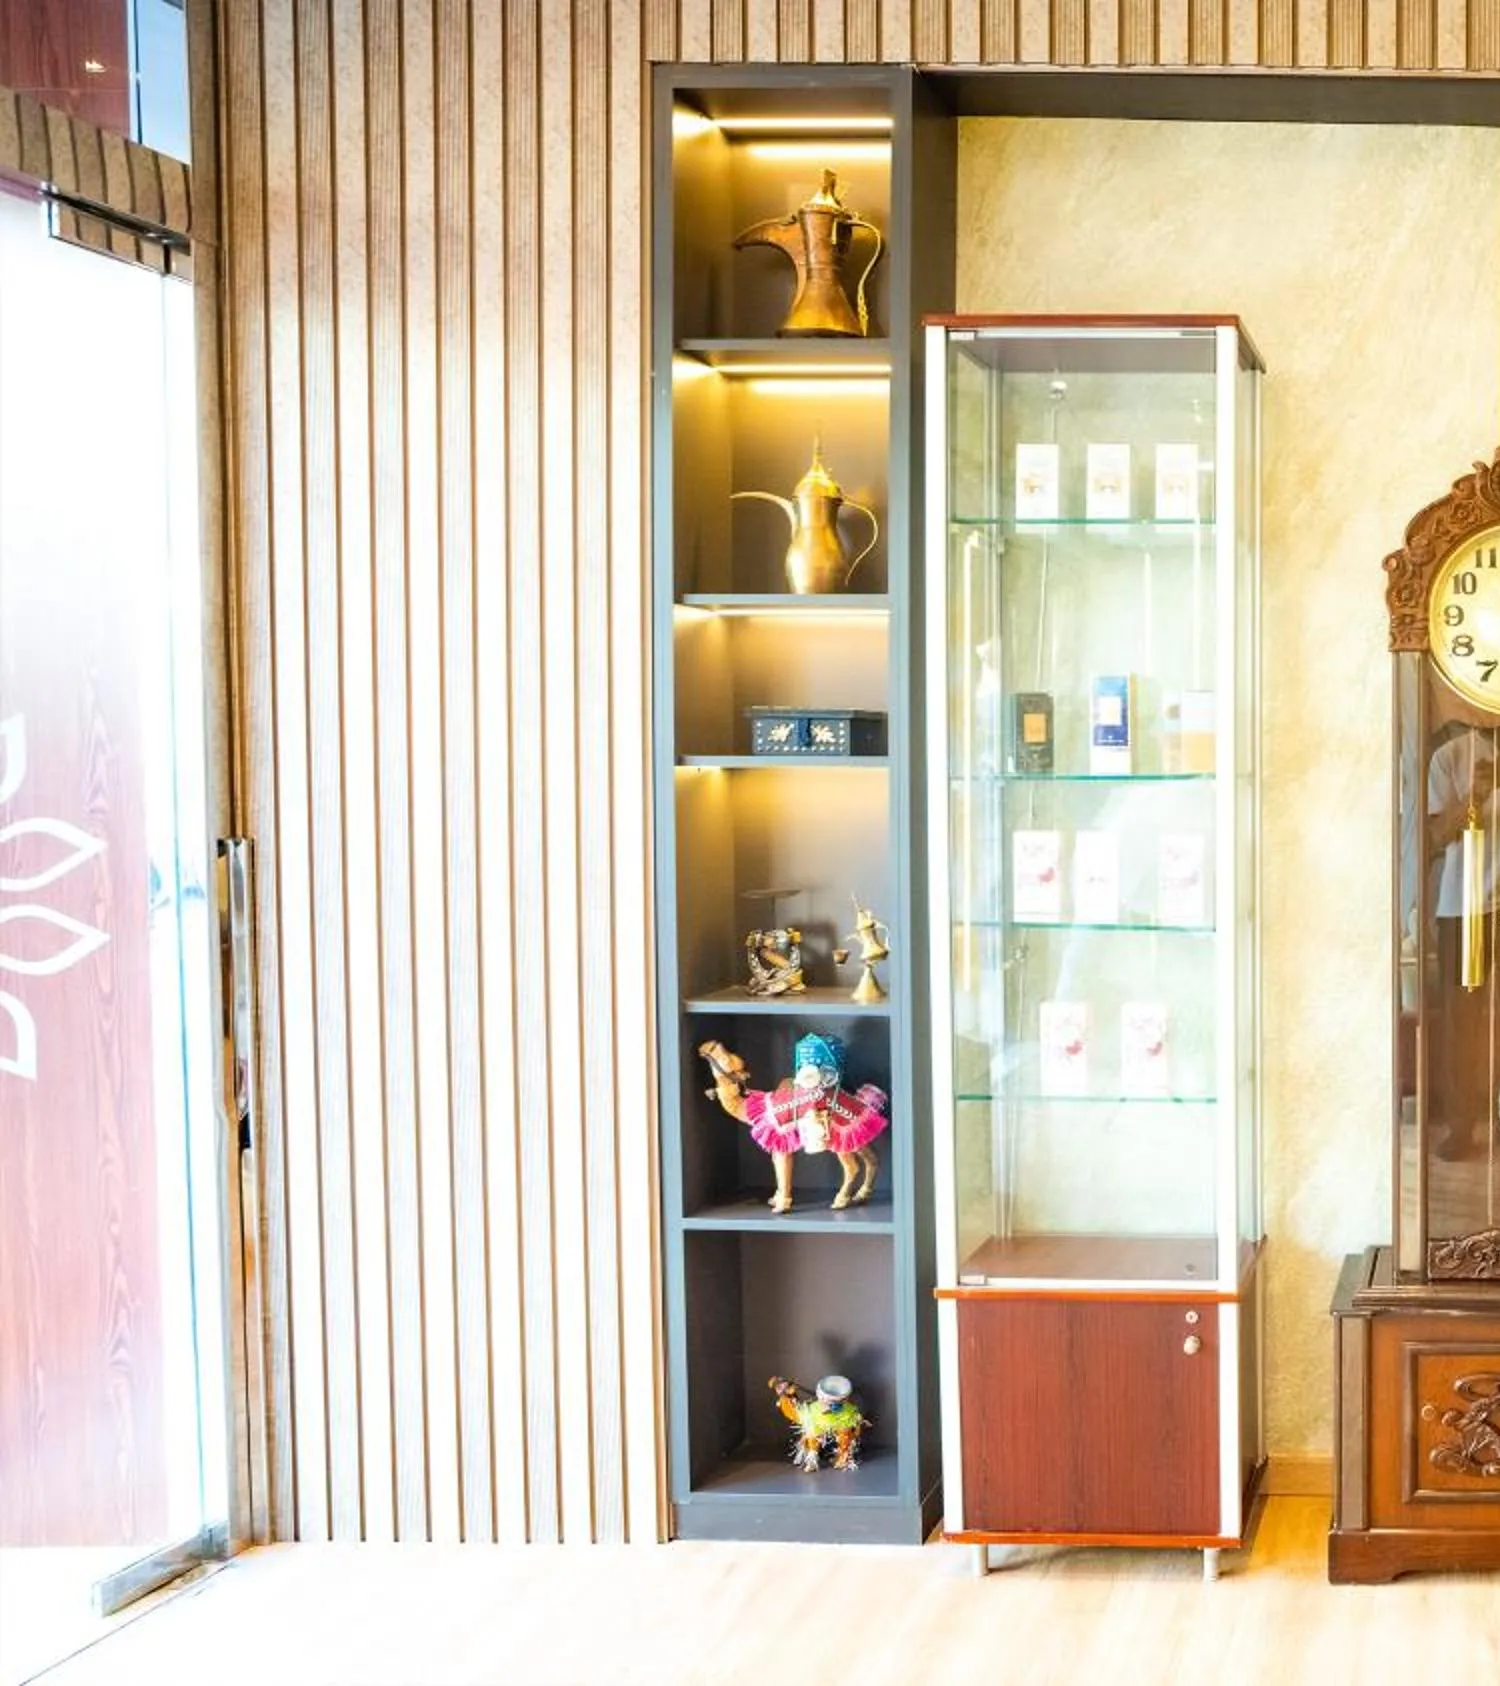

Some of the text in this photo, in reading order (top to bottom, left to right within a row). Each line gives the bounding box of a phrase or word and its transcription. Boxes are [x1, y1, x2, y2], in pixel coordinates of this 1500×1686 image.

[1475, 548, 1497, 568] 11
[1452, 571, 1477, 595] 10
[1443, 604, 1465, 627] 9
[1451, 634, 1475, 657] 8
[1475, 659, 1499, 683] 7
